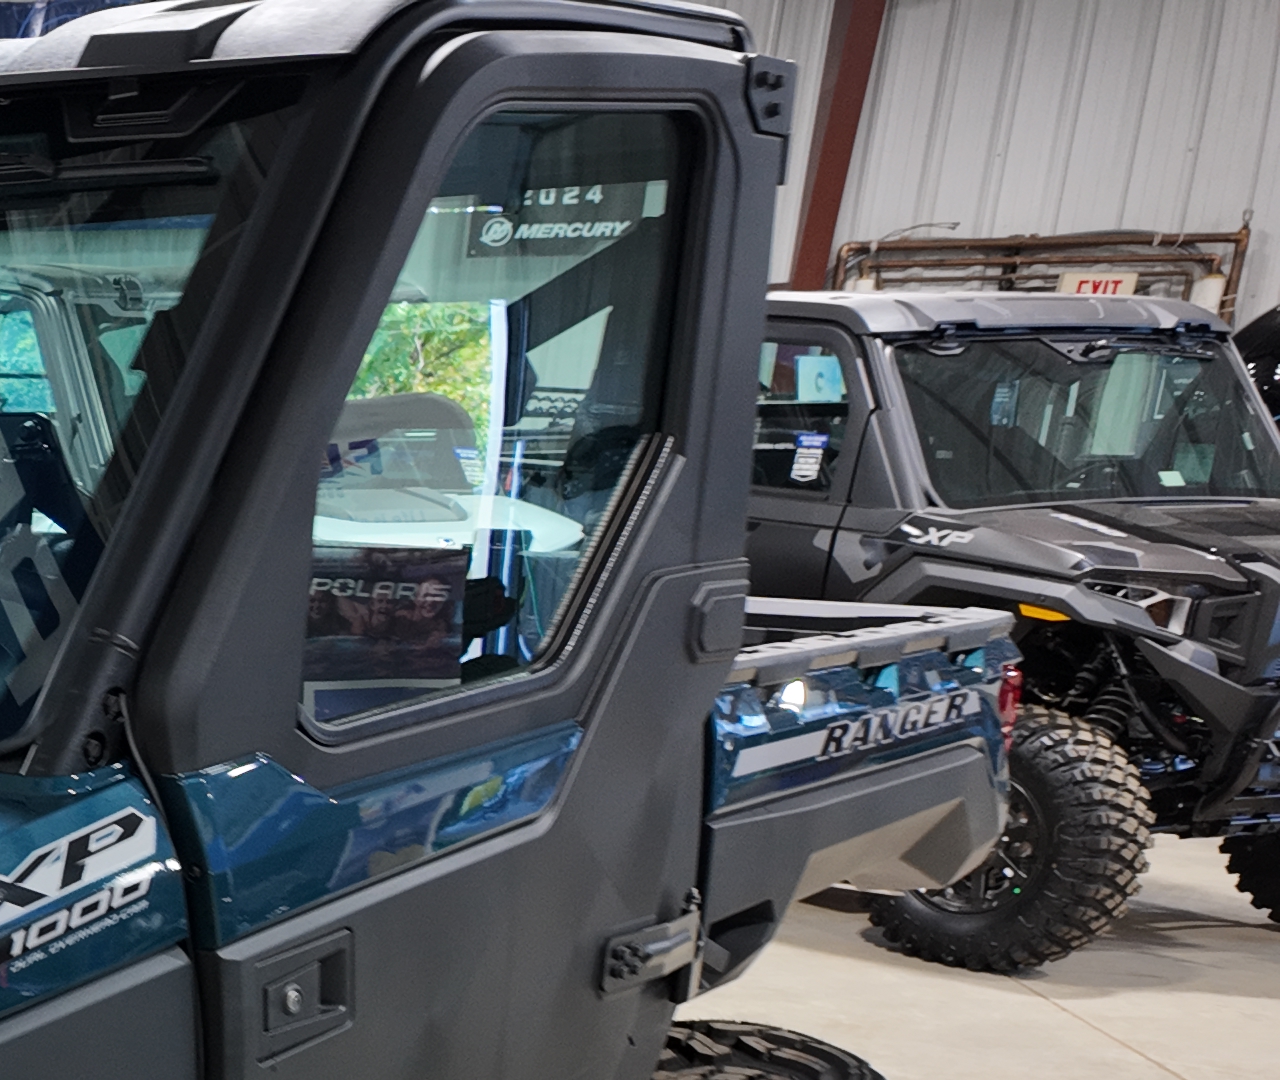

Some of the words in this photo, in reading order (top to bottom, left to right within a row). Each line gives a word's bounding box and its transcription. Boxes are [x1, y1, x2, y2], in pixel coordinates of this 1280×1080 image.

[514, 220, 633, 240] MERCURY
[908, 527, 975, 547] XP
[309, 577, 452, 602] POLARIS
[816, 691, 970, 760] RANGER
[8, 872, 154, 958] 1000
